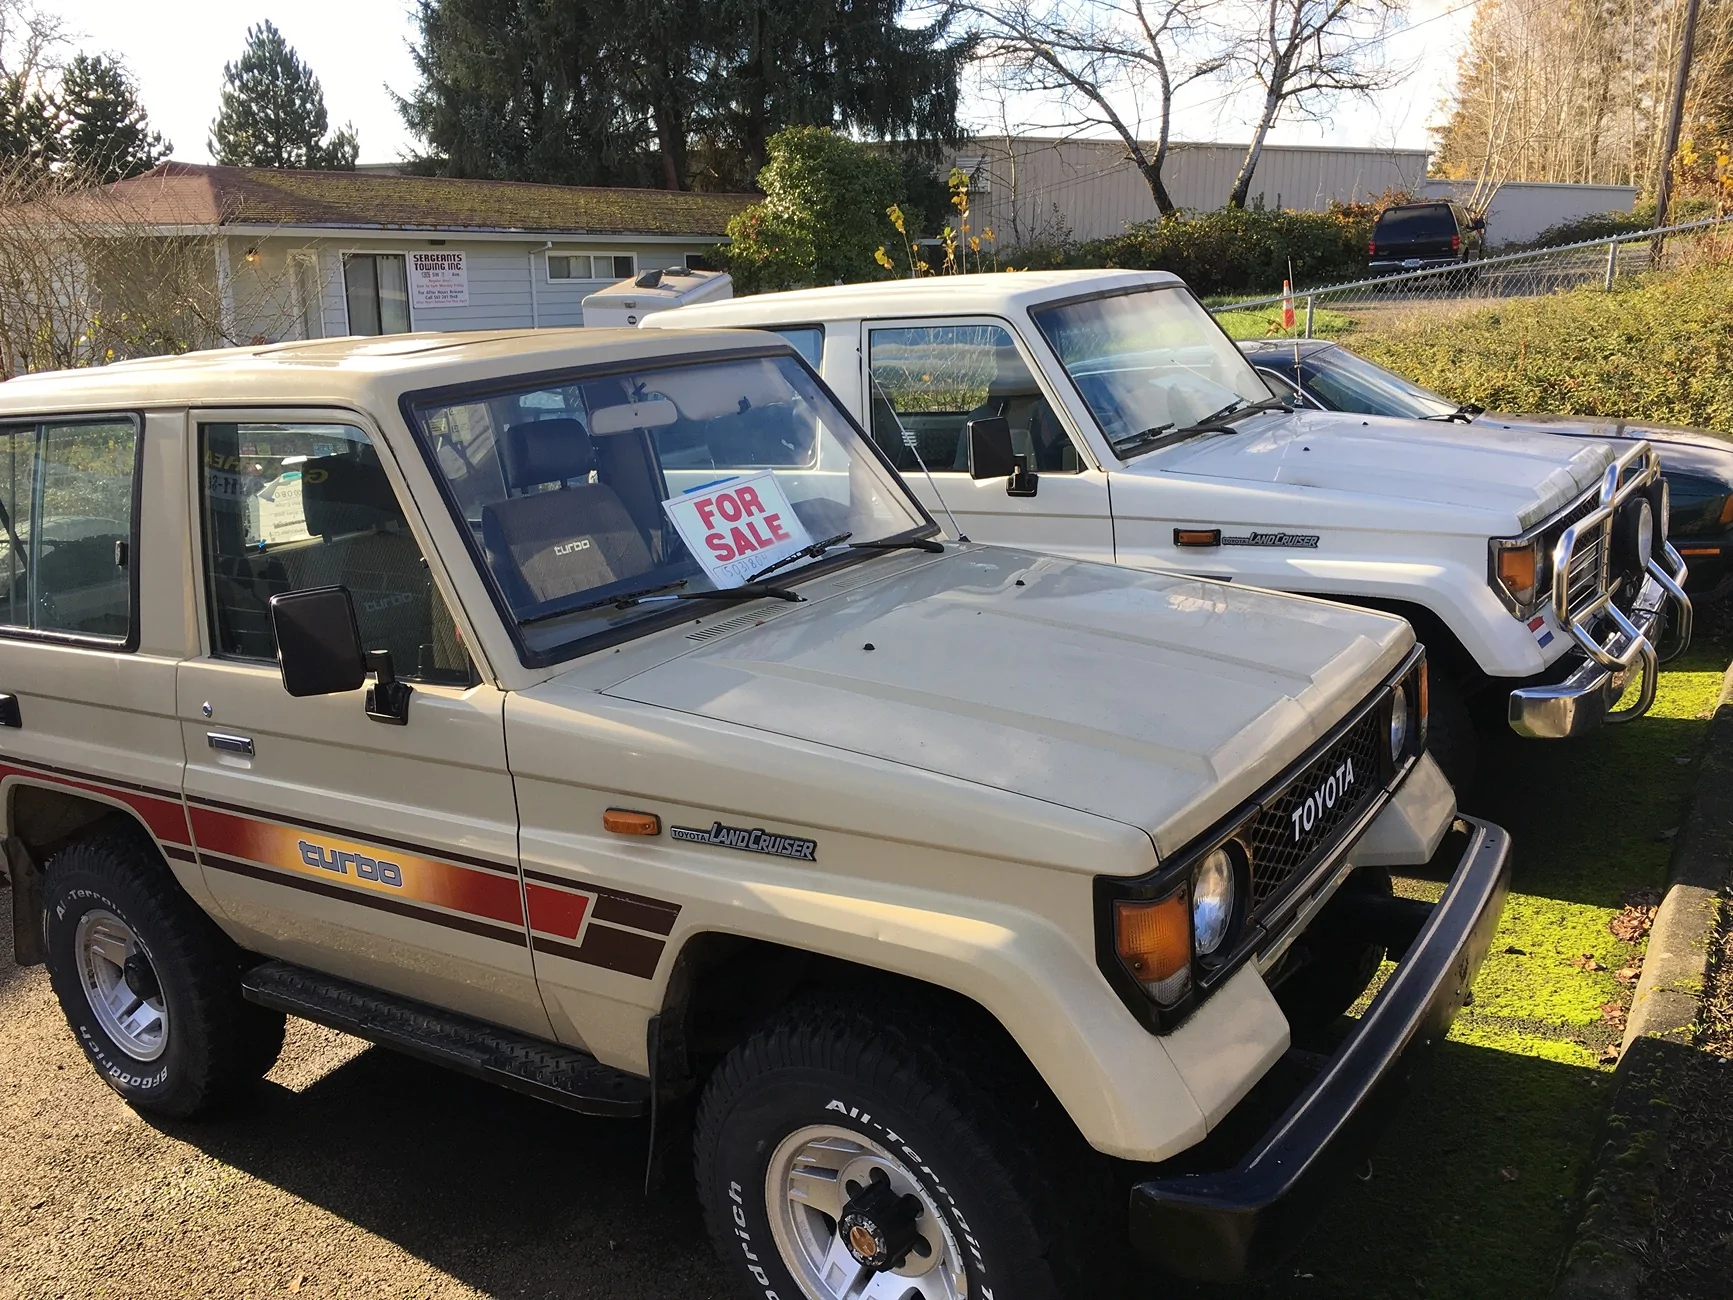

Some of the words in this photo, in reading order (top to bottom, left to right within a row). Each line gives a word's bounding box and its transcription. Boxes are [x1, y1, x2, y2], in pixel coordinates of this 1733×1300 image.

[413, 254, 462, 262] SERGEANTS
[694, 486, 766, 530] FOR
[554, 540, 590, 556] turbo
[704, 513, 792, 562] SALE
[1292, 758, 1354, 842] TOYOTA
[672, 829, 707, 841] TOYOTA
[298, 840, 402, 888] turbo
[80, 1026, 168, 1088] BFGoodrich
[825, 1100, 986, 1274] All-Terrain
